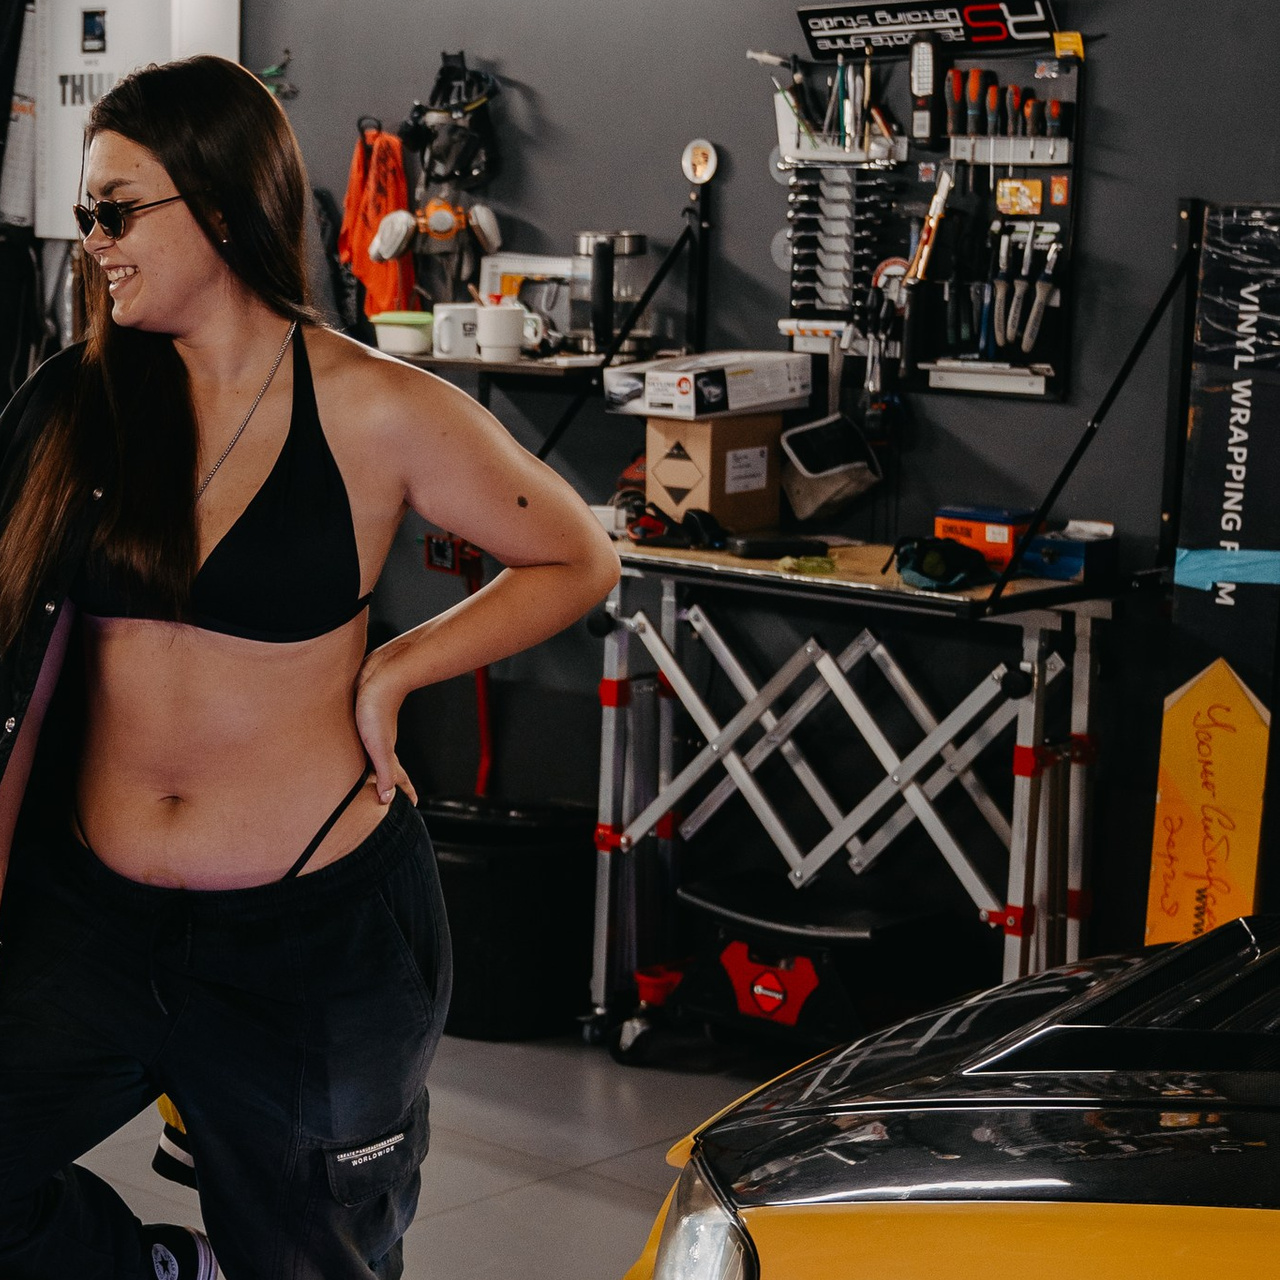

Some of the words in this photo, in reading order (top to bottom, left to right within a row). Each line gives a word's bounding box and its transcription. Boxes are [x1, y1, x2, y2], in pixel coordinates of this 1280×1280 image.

[807, 13, 872, 31] Studio
[875, 7, 963, 27] Detailing
[1231, 282, 1261, 371] VINYL
[1220, 378, 1253, 532] WRAPPING
[1213, 539, 1240, 607] FM
[350, 1145, 396, 1168] WORLDWIDE
